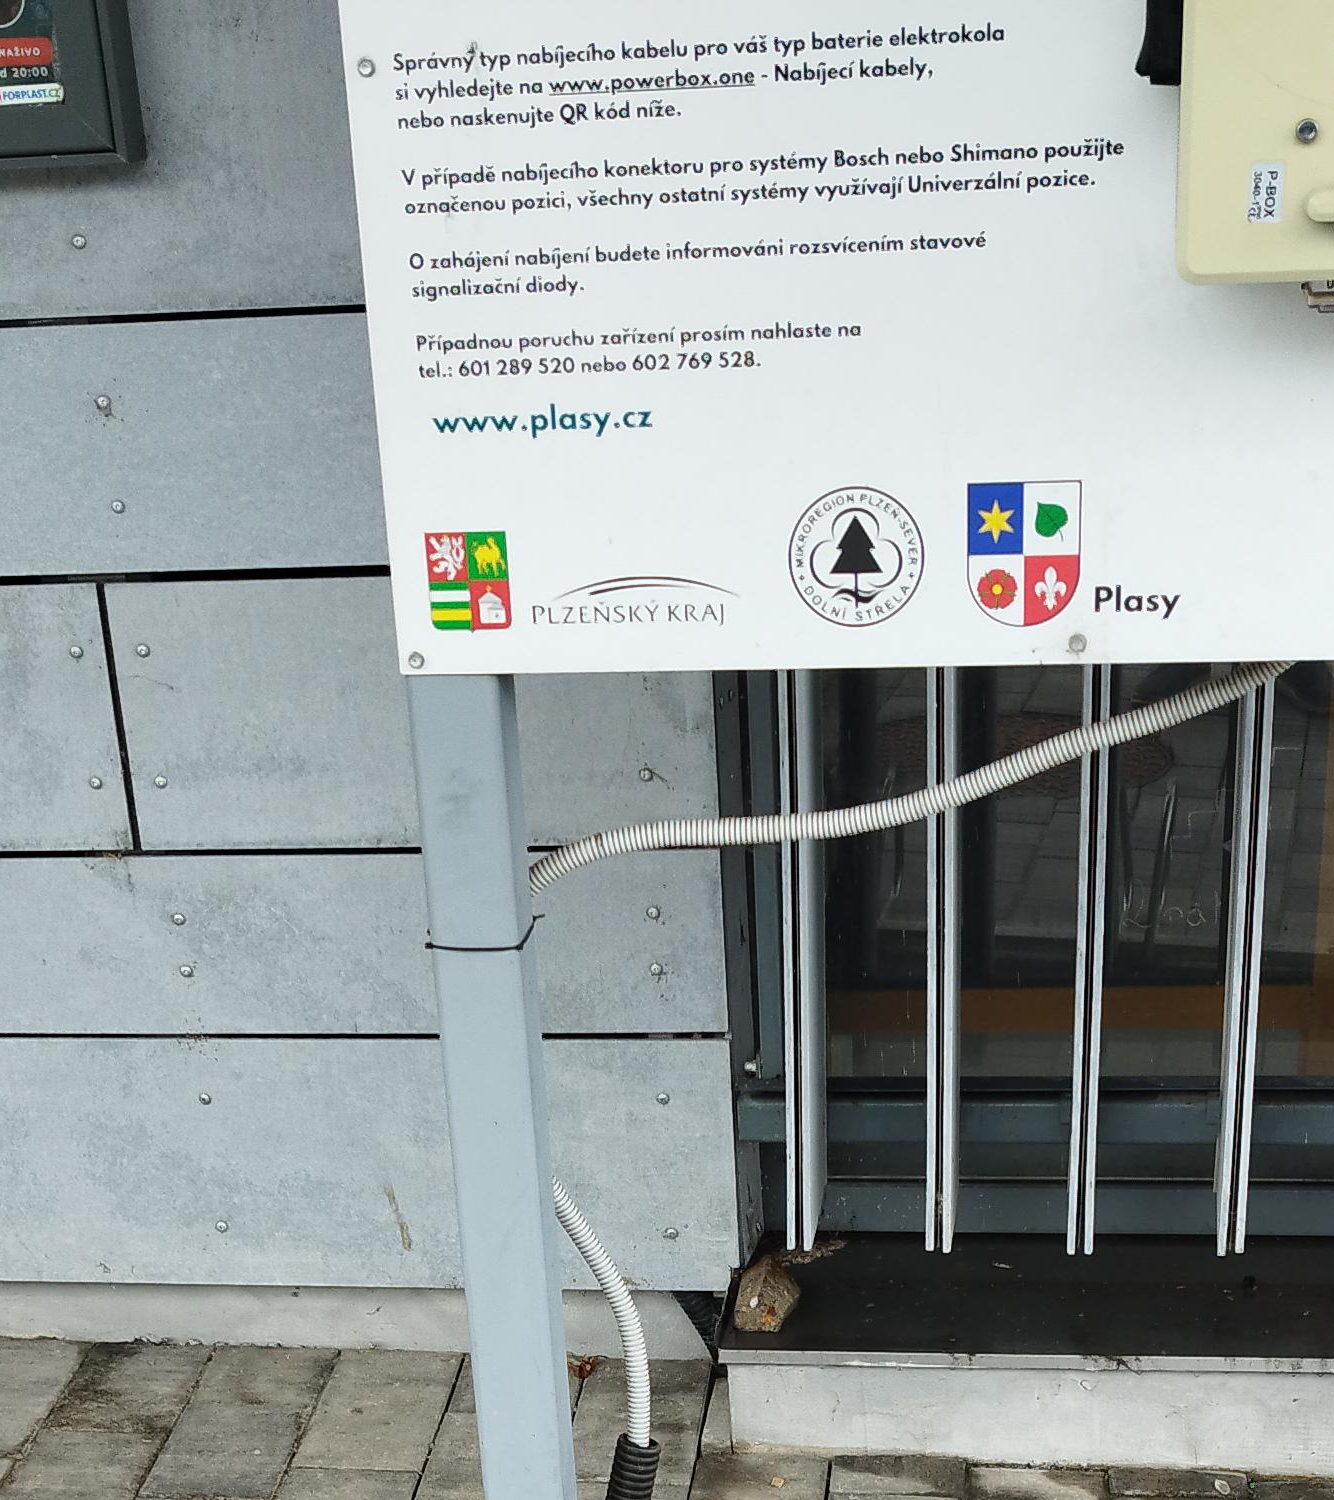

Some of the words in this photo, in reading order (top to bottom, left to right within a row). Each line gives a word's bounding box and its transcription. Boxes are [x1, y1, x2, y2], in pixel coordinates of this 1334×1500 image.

[393, 51, 476, 76] Správný
[479, 51, 511, 73] typ
[516, 42, 616, 69] nabíjecího
[621, 38, 688, 60] kabelu
[693, 42, 728, 62] pro
[733, 34, 768, 54] váš
[773, 36, 806, 58] typ
[811, 29, 884, 51] baterie
[888, 21, 1005, 47] elektrokola
[12, 66, 49, 78] 20:00
[395, 82, 409, 101] si
[413, 77, 514, 105] vyhledejte
[519, 82, 544, 95] na
[547, 67, 756, 97] www.powerbox.one
[774, 59, 855, 86] Nabíjecí
[859, 56, 934, 81] kabely,
[2, 87, 60, 101] FORPLAST.CZ
[397, 109, 445, 130] nebo
[450, 105, 555, 129] naskenujte
[559, 102, 589, 126] QR
[594, 99, 631, 121] kód
[636, 99, 682, 119] níže.
[400, 168, 416, 186] V
[421, 164, 496, 191] případě
[501, 160, 599, 186] nabíjecího
[603, 157, 704, 178] konektoru
[709, 160, 744, 179] pro
[749, 151, 828, 177] systémy
[833, 146, 890, 168] Bosch
[895, 145, 945, 165] nebo
[949, 142, 1039, 163] Shimano
[1044, 137, 1125, 164] použijte
[404, 195, 506, 215] označenou
[511, 190, 572, 215] pozici,
[577, 187, 654, 210] všechny
[658, 183, 726, 204] ostatní
[730, 182, 810, 206] systémy
[814, 175, 904, 202] využívají
[907, 170, 1023, 194] Univerzální
[1026, 169, 1096, 194] pozice.
[1263, 170, 1278, 218] P-BOX
[409, 252, 425, 270] O
[430, 249, 510, 273] zahájení
[514, 246, 591, 270] nabíjení
[595, 243, 661, 263] budete
[666, 238, 784, 260] informováni
[789, 234, 904, 255] rozsvícením
[909, 230, 987, 251] stavové
[411, 277, 521, 303] signalizační
[525, 274, 585, 297] diody.
[415, 332, 513, 355] Případnou
[518, 328, 595, 353] poruchu
[600, 326, 676, 345] zařízení
[680, 324, 745, 348] prosím
[750, 320, 832, 340] nahlaste
[837, 325, 862, 337] na
[418, 360, 453, 379] tel.:
[458, 359, 490, 377] 601
[496, 358, 533, 376] 289
[538, 356, 575, 375] 520
[580, 355, 627, 373] nebo
[632, 353, 670, 371] 602
[677, 351, 713, 370] 769
[718, 350, 761, 369] 528.
[432, 403, 653, 439] www.plasy.cz
[794, 493, 855, 568] MIKROREGION
[859, 493, 918, 566] PLZEŇ-SEVER
[531, 599, 659, 625] PLZEŇSKÝ
[667, 602, 725, 627] KRAJ
[803, 585, 847, 620] DOLNÍ
[854, 584, 911, 622] STŘELA
[1094, 584, 1181, 620] Plasy
